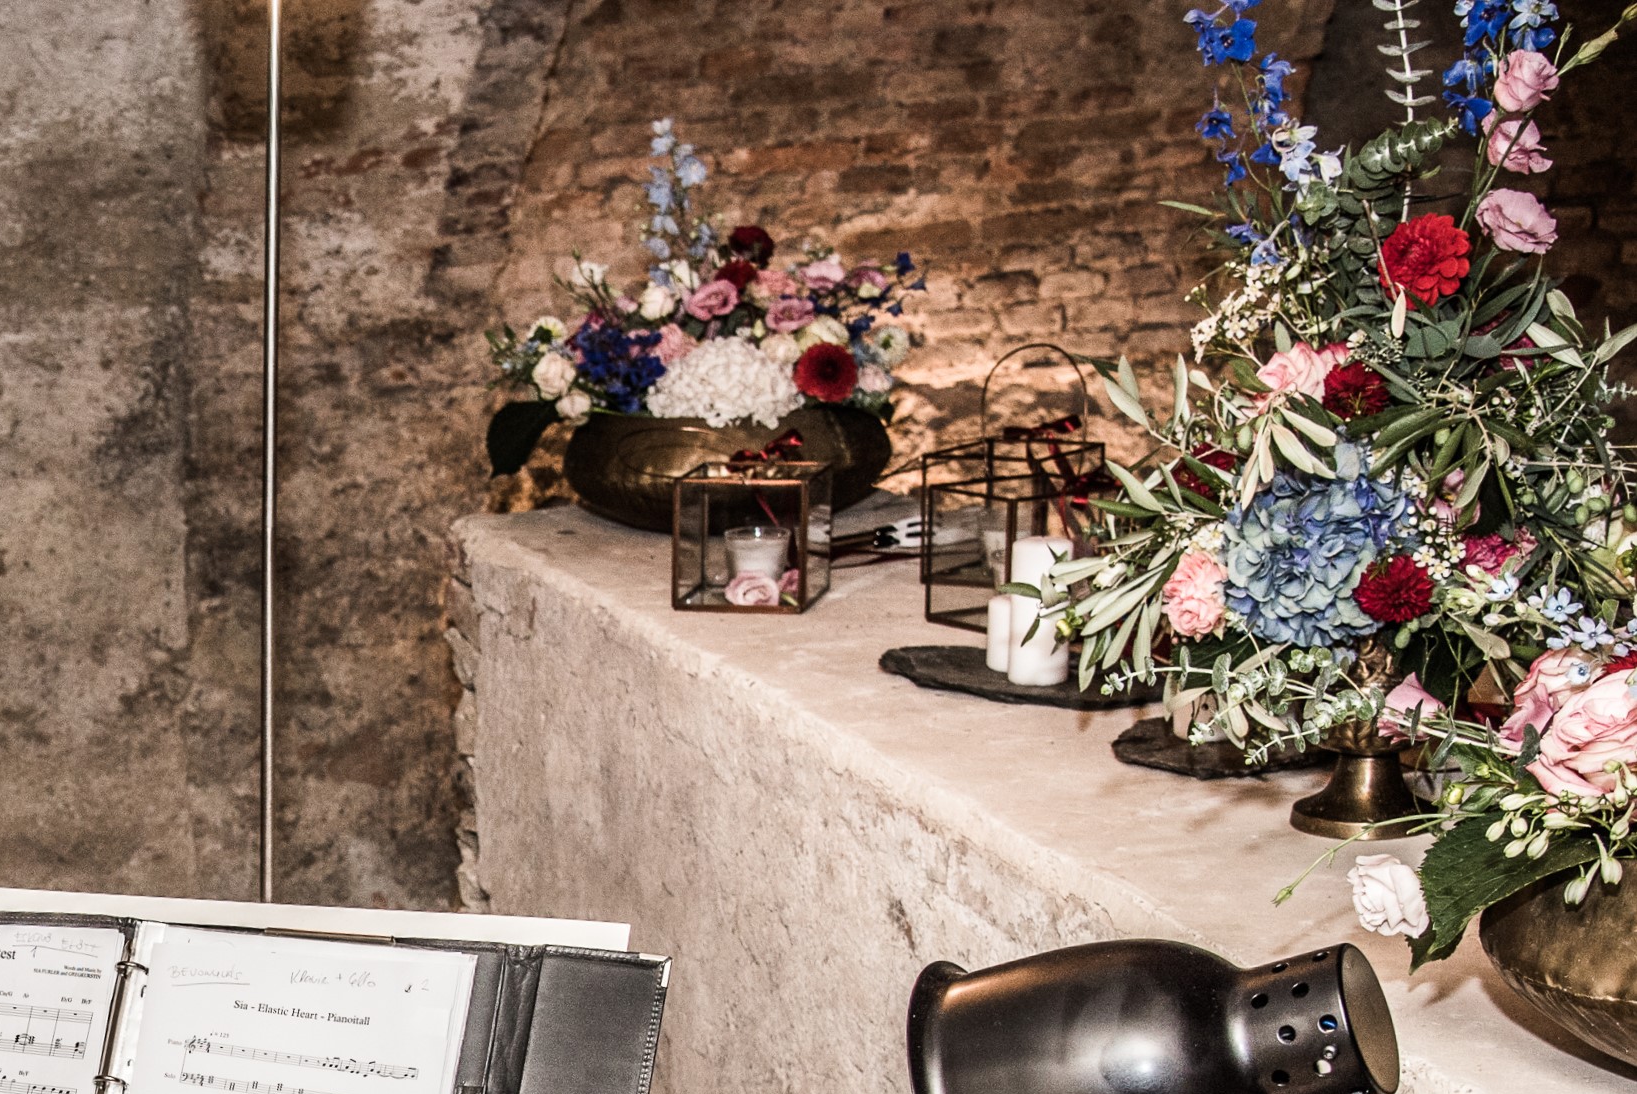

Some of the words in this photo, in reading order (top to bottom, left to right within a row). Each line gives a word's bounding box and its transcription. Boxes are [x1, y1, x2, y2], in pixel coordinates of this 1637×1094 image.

[233, 1000, 249, 1010] Sia
[258, 1002, 289, 1016] Elastic
[291, 1007, 318, 1021] Heart
[326, 1012, 371, 1026] Pianoitall
